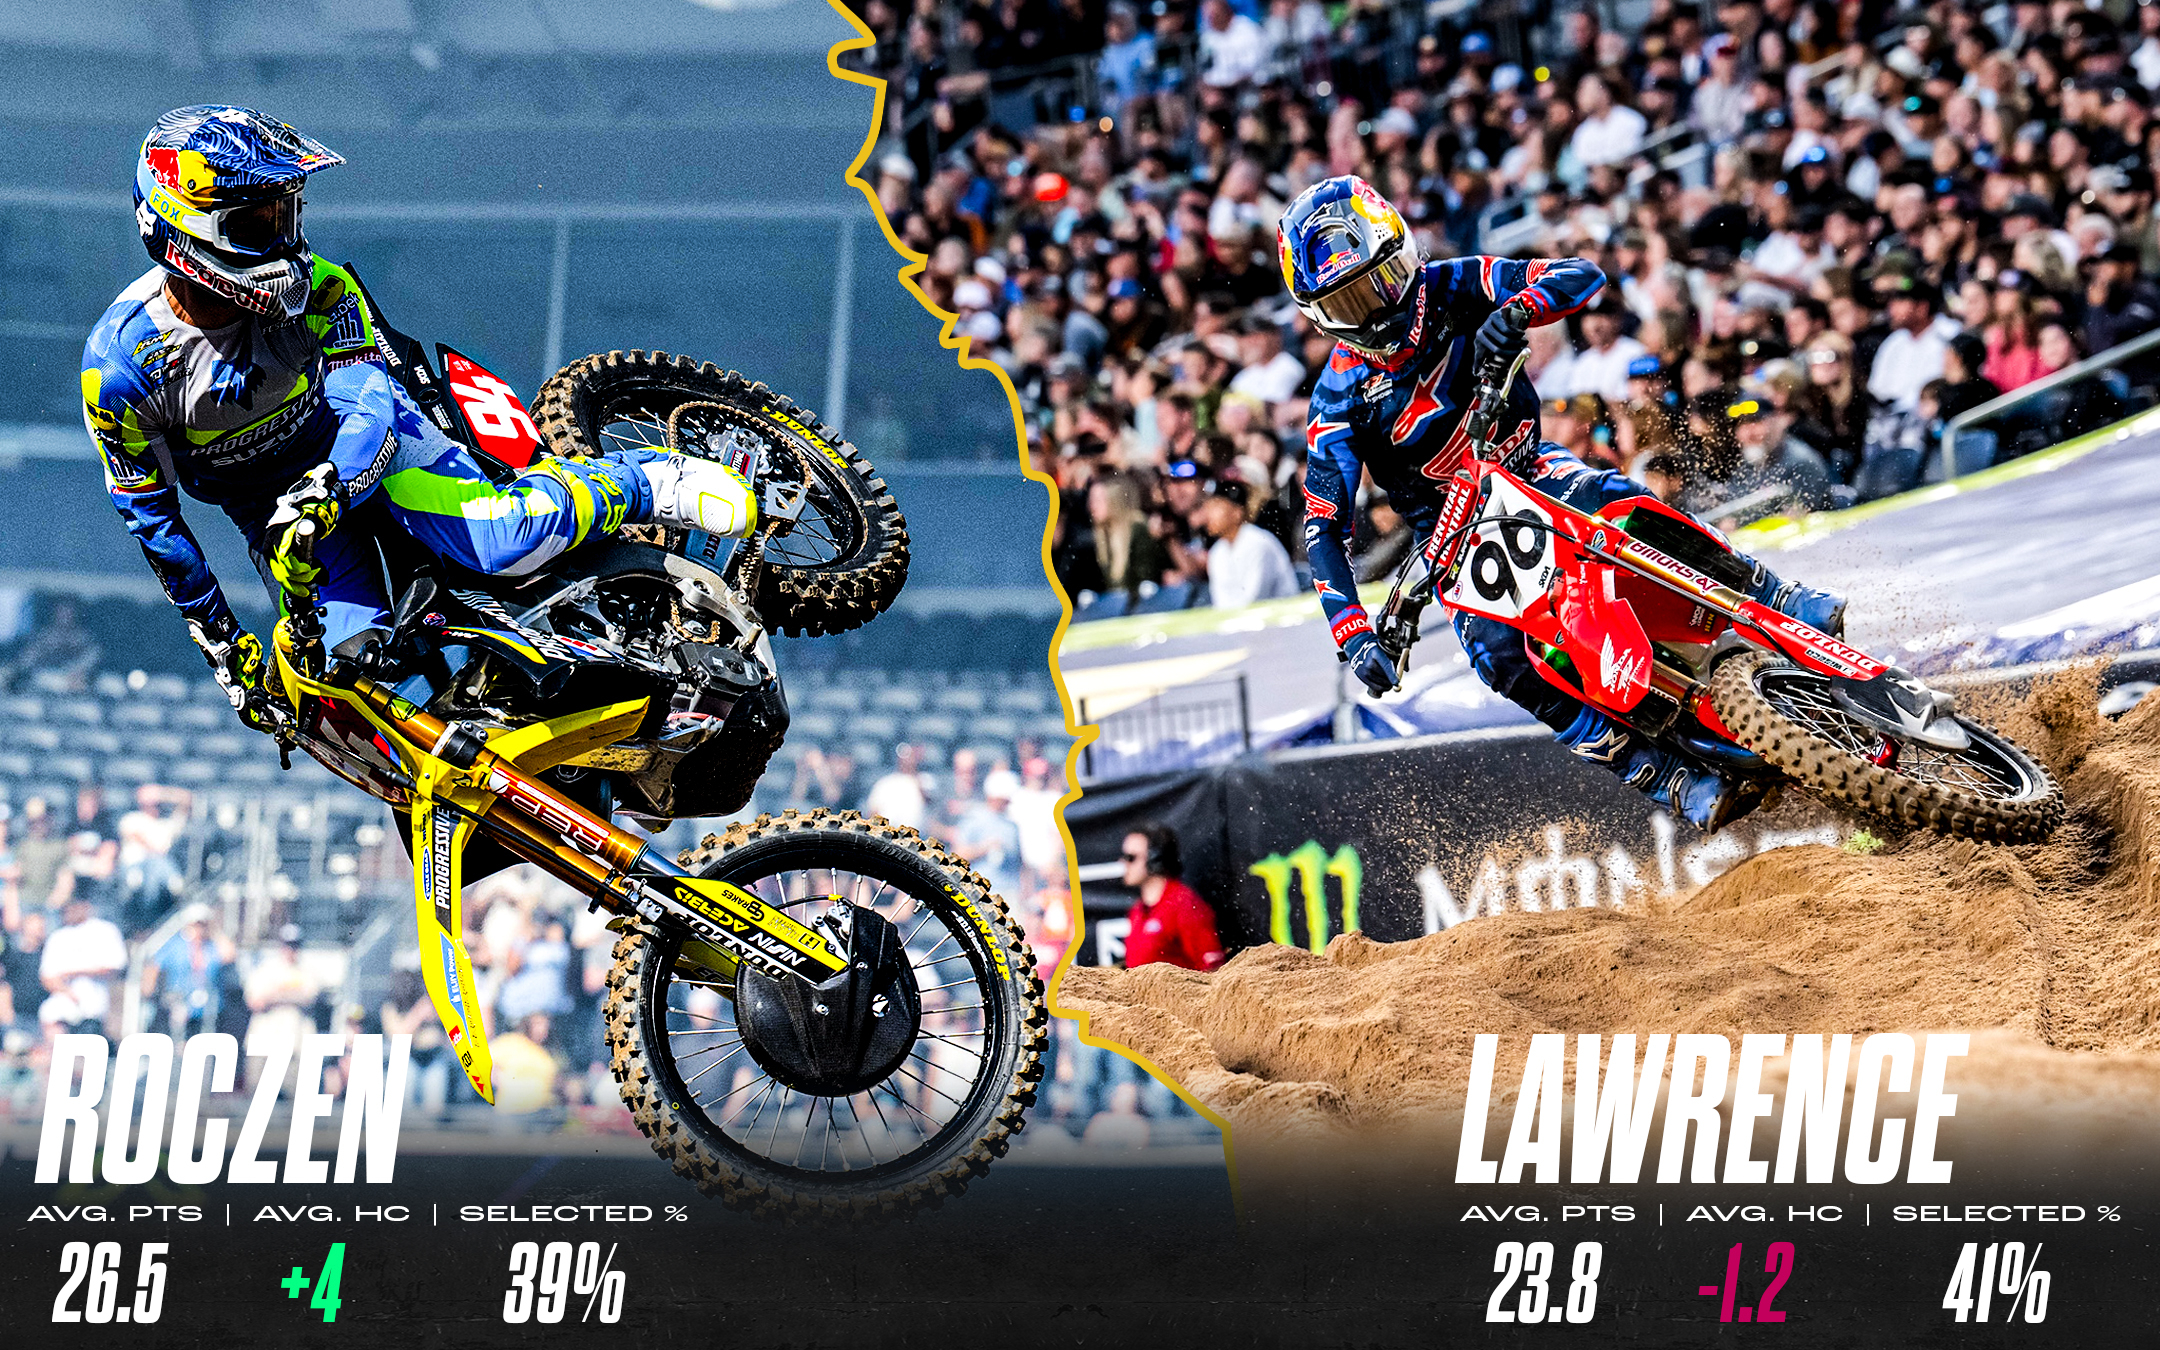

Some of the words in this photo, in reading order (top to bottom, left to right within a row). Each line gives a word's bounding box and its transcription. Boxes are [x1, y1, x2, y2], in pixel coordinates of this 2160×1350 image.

[152, 193, 181, 222] FOX
[371, 326, 402, 367] DUNLOP
[450, 375, 545, 446] 94
[769, 409, 849, 469] DUNLOP
[348, 430, 398, 498] PROGRESSIVE
[1428, 482, 1460, 556] RENTHAL
[1457, 511, 1479, 562] SUPERCRSS
[702, 535, 722, 561] DID
[1471, 495, 1547, 618] 96
[1630, 541, 1694, 580] SHOWA
[1609, 647, 1632, 694] HONDA
[1780, 621, 1881, 671] DUNLOP
[511, 794, 603, 851] REP
[435, 806, 452, 910] PROGRESSIVE
[673, 886, 751, 933] ACERBIS
[951, 892, 1010, 981] DUNLOP
[677, 913, 788, 980] DUNLOP
